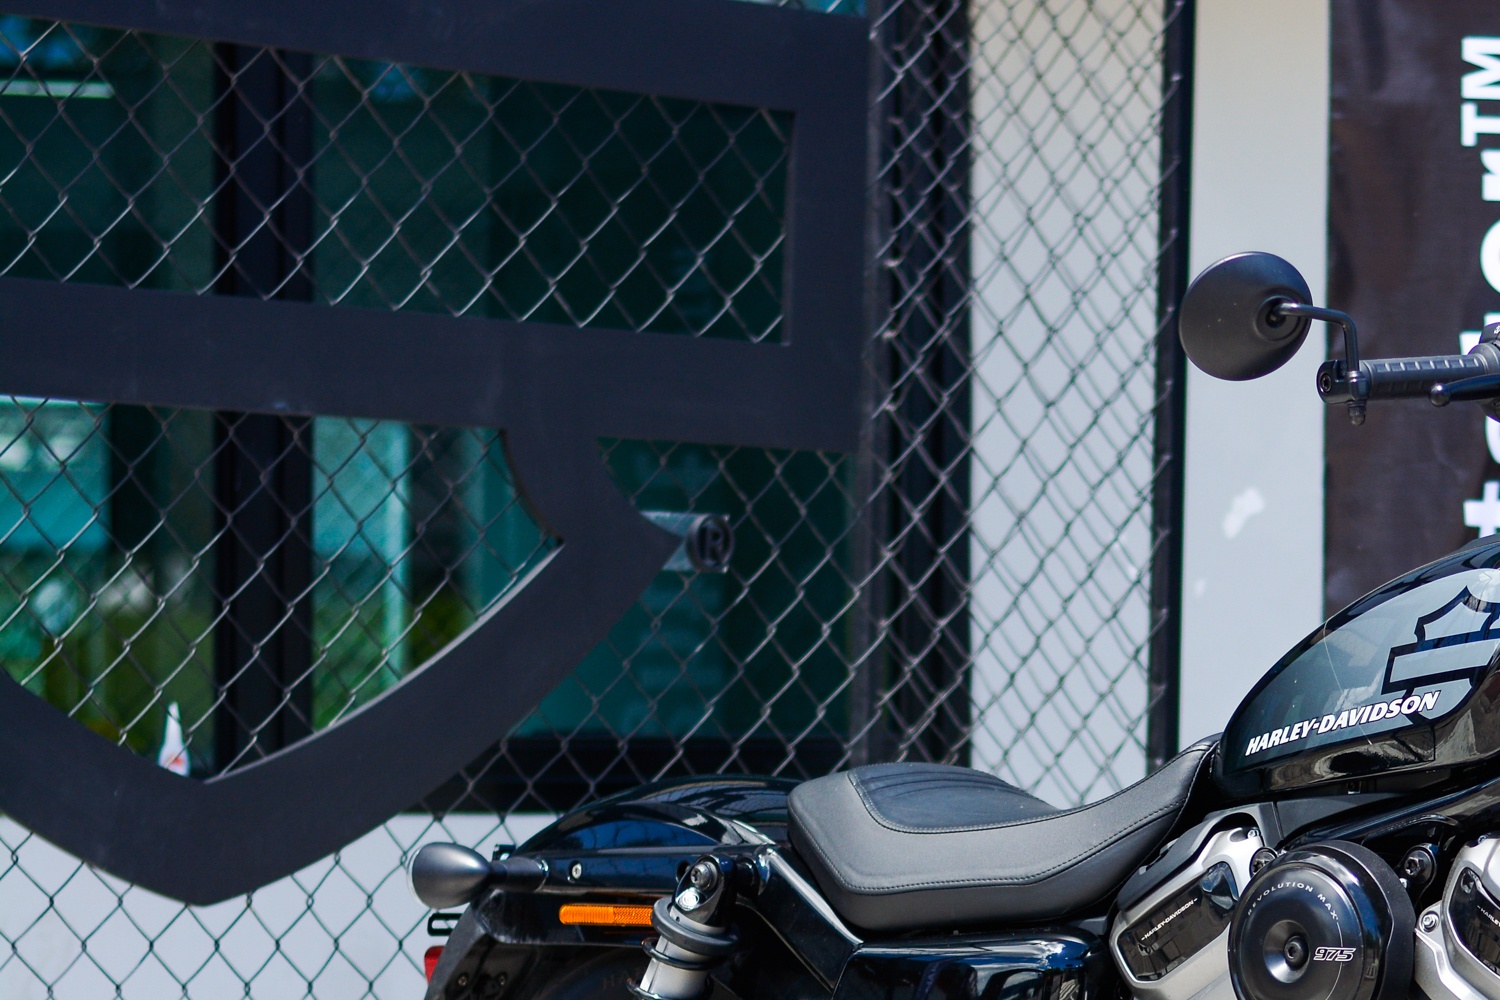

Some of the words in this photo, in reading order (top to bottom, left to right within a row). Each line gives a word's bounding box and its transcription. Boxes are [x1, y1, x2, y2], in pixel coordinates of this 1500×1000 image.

[1245, 690, 1441, 757] HARLEY-DAVIDSON
[1247, 881, 1314, 916] REVOLUTION
[1313, 946, 1356, 962] 975
